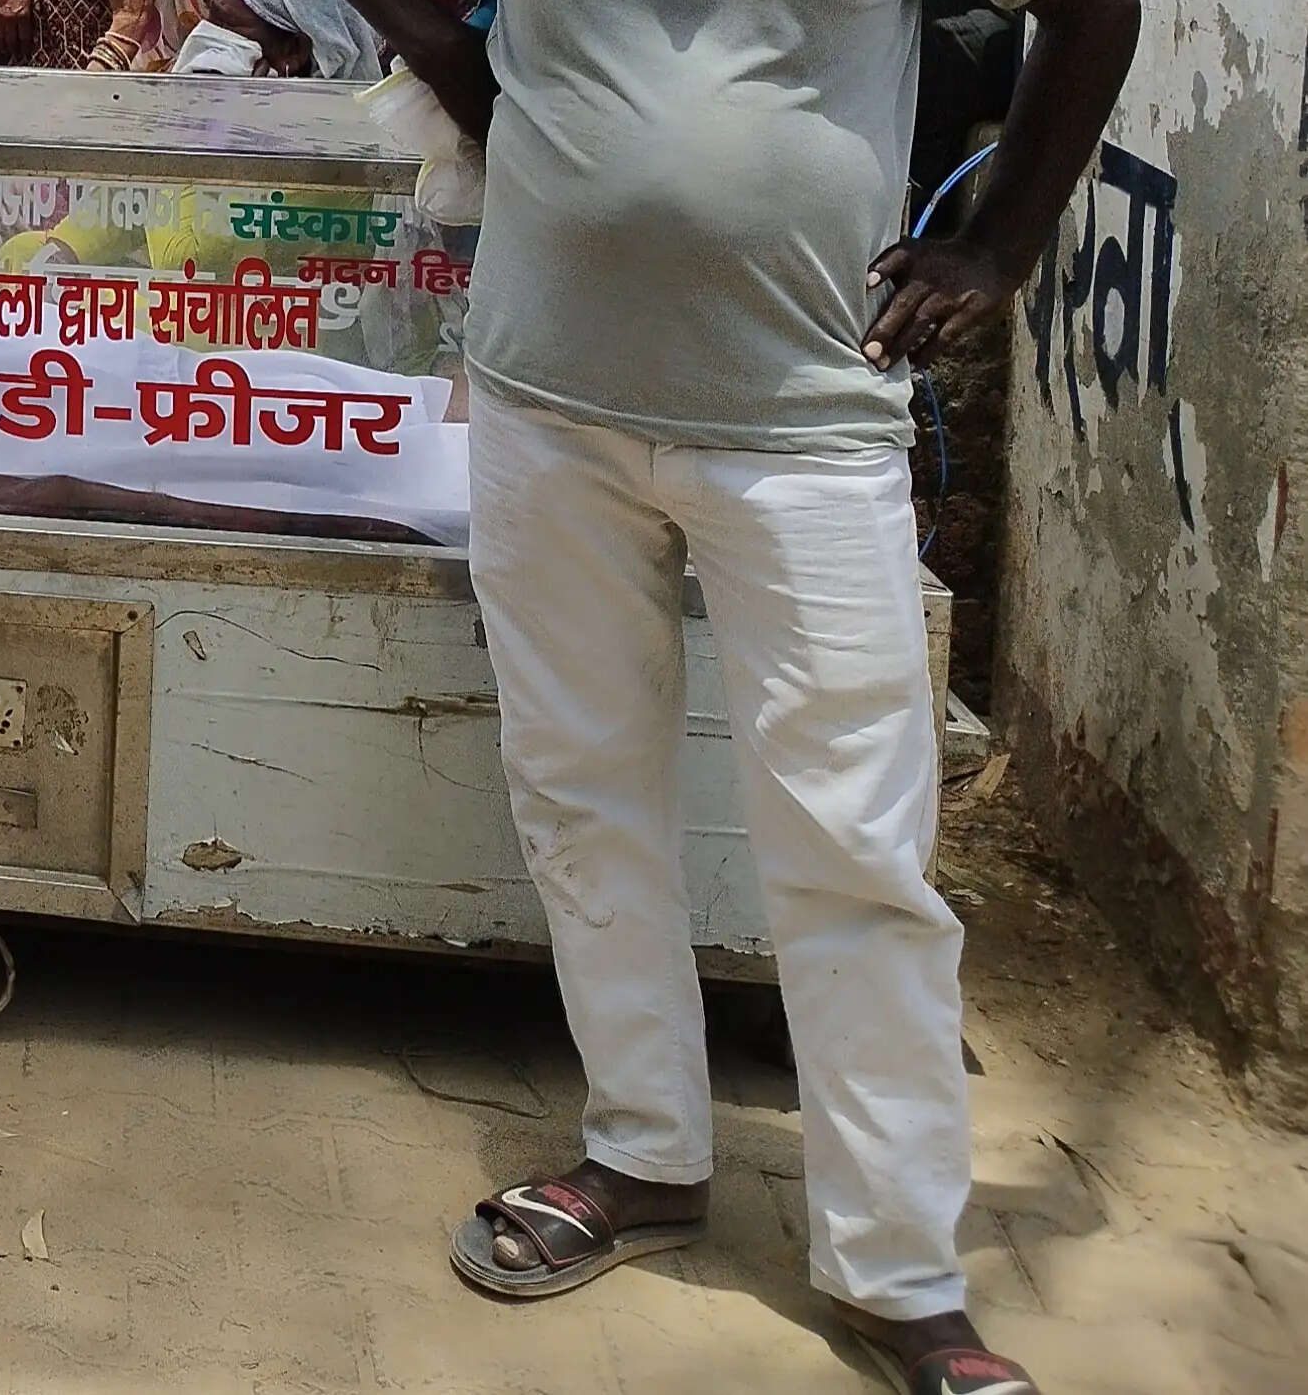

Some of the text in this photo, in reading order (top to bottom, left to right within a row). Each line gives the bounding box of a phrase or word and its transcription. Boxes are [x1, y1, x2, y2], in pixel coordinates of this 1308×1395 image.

[229, 191, 403, 248] संस्कार
[296, 255, 401, 290] मदन
[56, 276, 139, 348] द्वारा
[148, 257, 322, 351] संचालित
